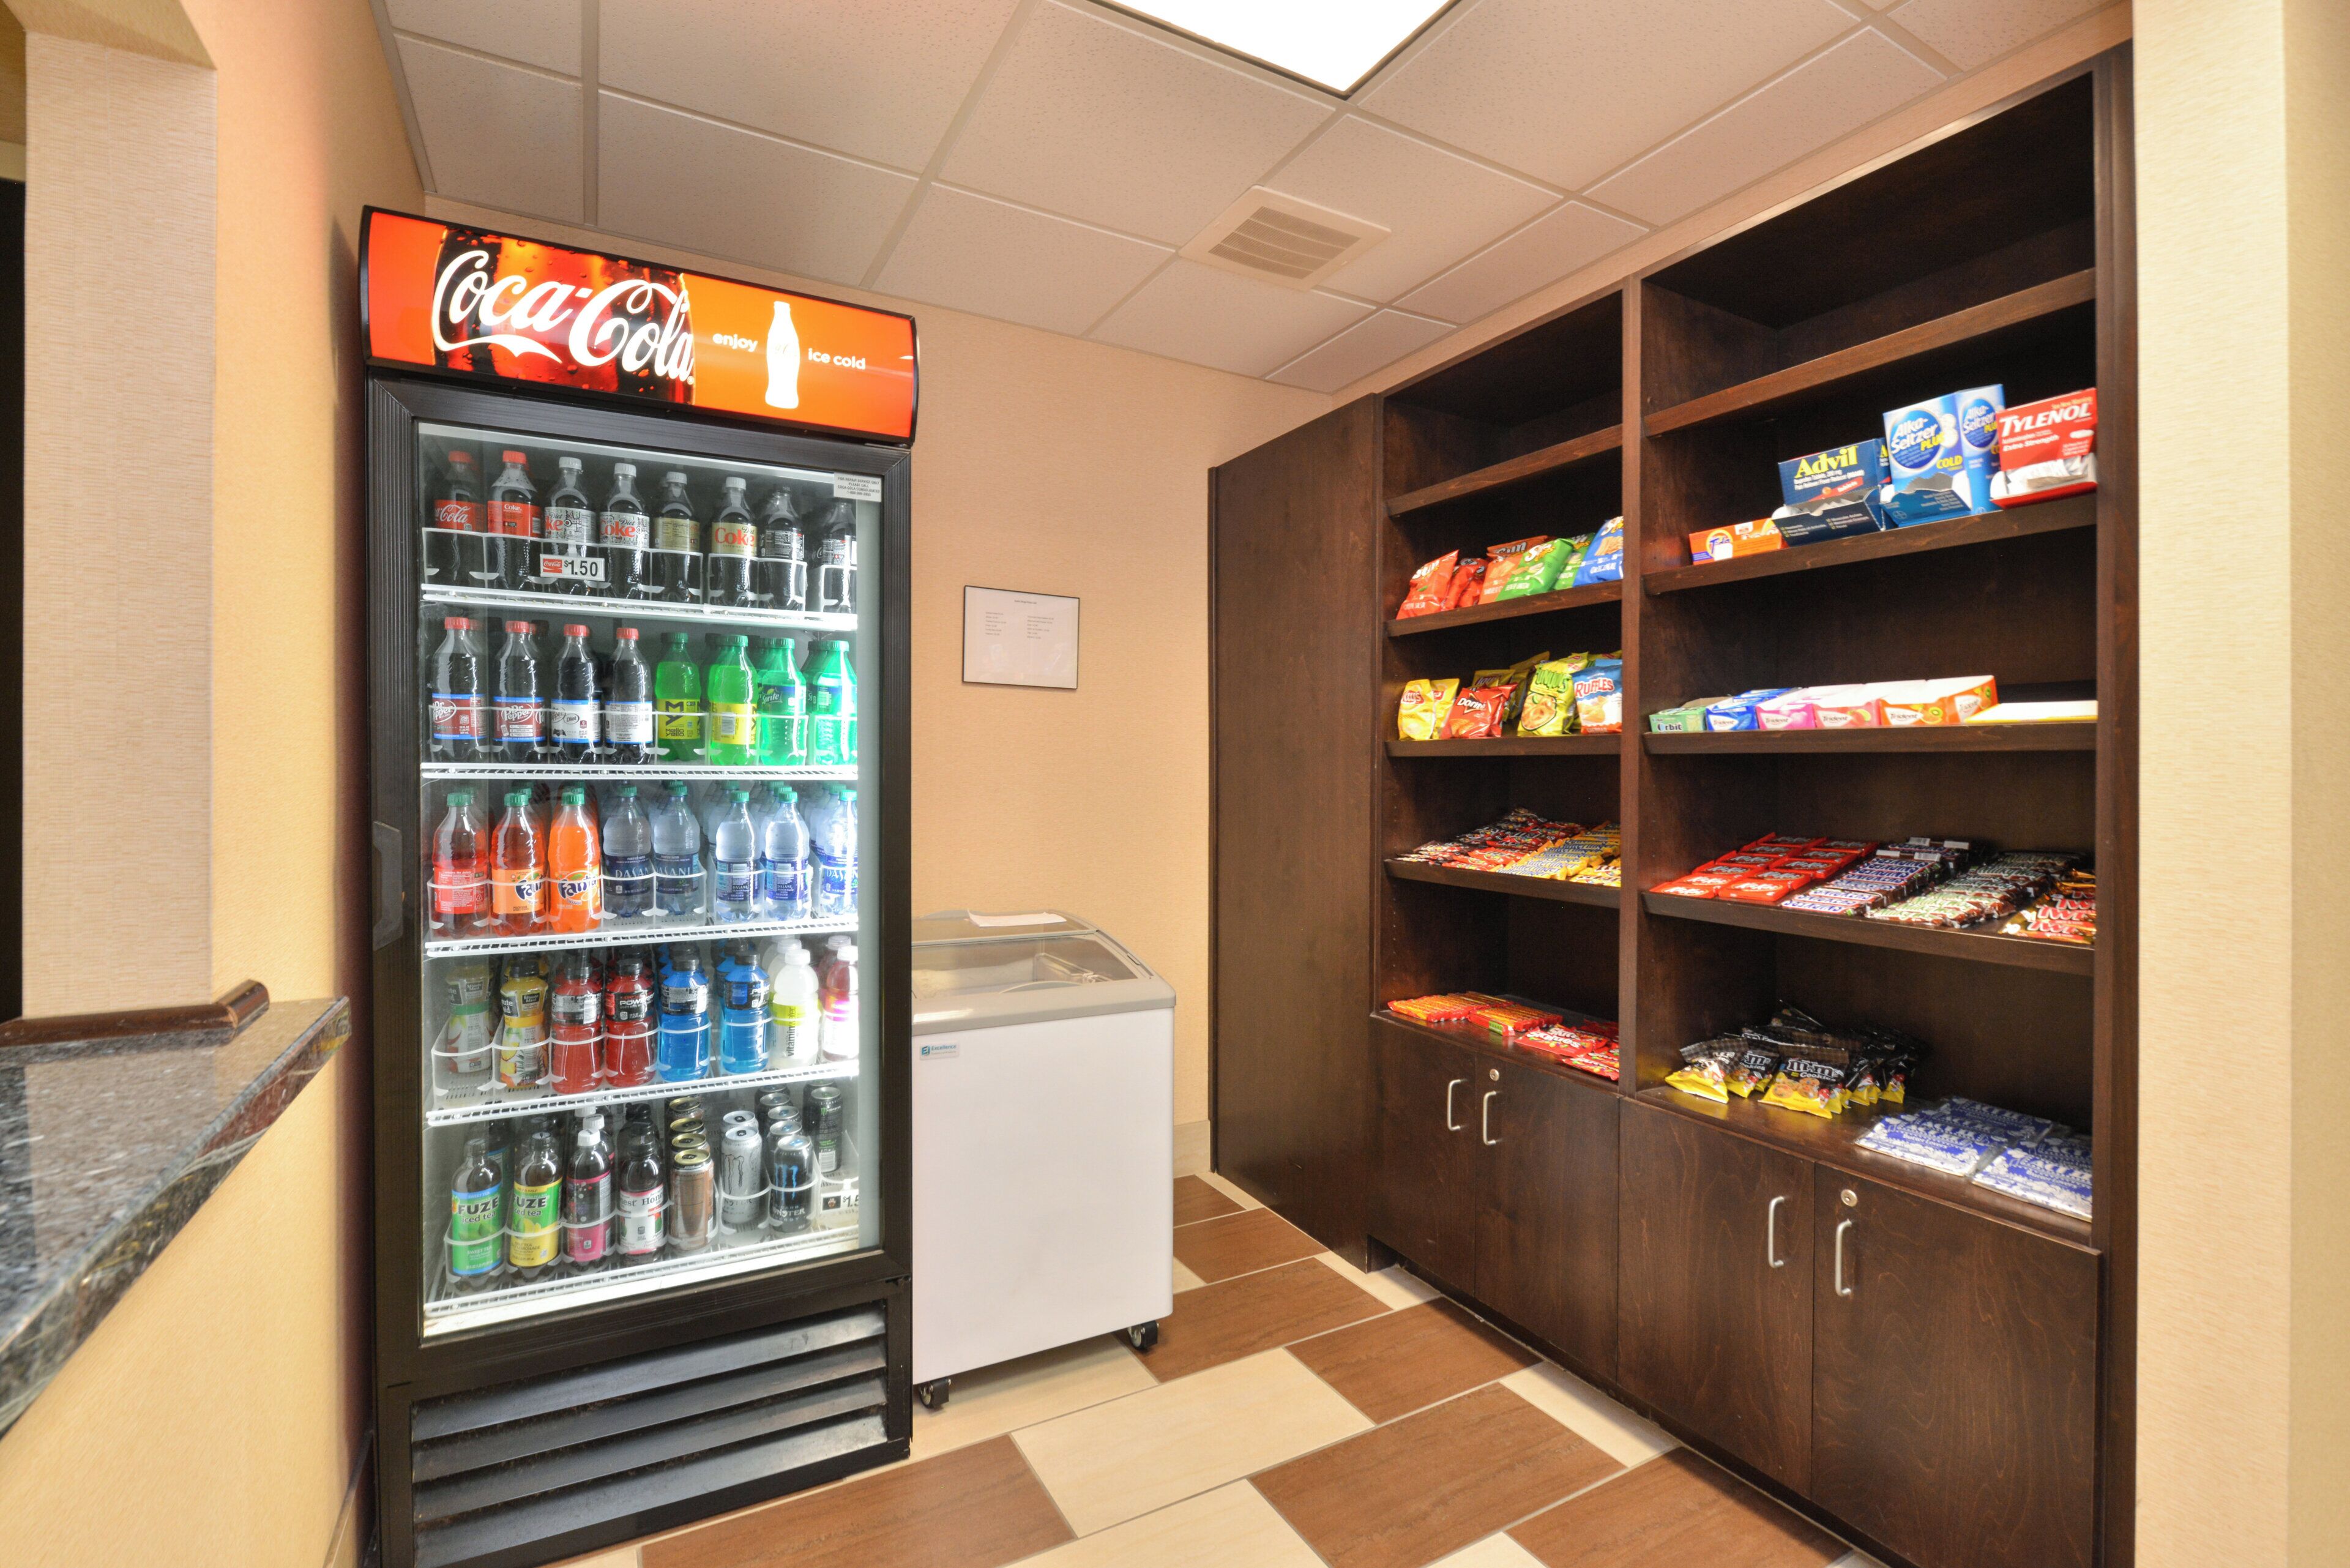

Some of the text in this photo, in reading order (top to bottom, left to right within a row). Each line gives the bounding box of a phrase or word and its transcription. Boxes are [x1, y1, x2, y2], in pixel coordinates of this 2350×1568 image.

[431, 250, 694, 379] Coca-Cola
[712, 334, 758, 352] enjoy
[808, 348, 866, 370] ice cold
[1984, 421, 1997, 433] PLU
[1999, 402, 2092, 437] TYLENOL
[1892, 417, 1928, 441] Alka-
[1891, 424, 1938, 454] Seltzer
[1920, 432, 1945, 451] PLUS
[2024, 435, 2060, 447] Strength
[1794, 446, 1859, 478] Advil
[1936, 455, 1963, 469] COLD
[545, 516, 564, 531] ke
[715, 527, 755, 547] Coke
[564, 560, 598, 577] $1.50
[1575, 678, 1614, 698] RUFFLES
[761, 692, 780, 704] Sprite
[504, 708, 531, 721] Pepper
[1657, 723, 1682, 731] Orbit
[558, 875, 597, 899] Fanta
[1526, 1031, 1581, 1048] Skittles
[1800, 1072, 1837, 1081] Cookies
[458, 1197, 499, 1215] FUZE
[483, 1211, 496, 1220] tea
